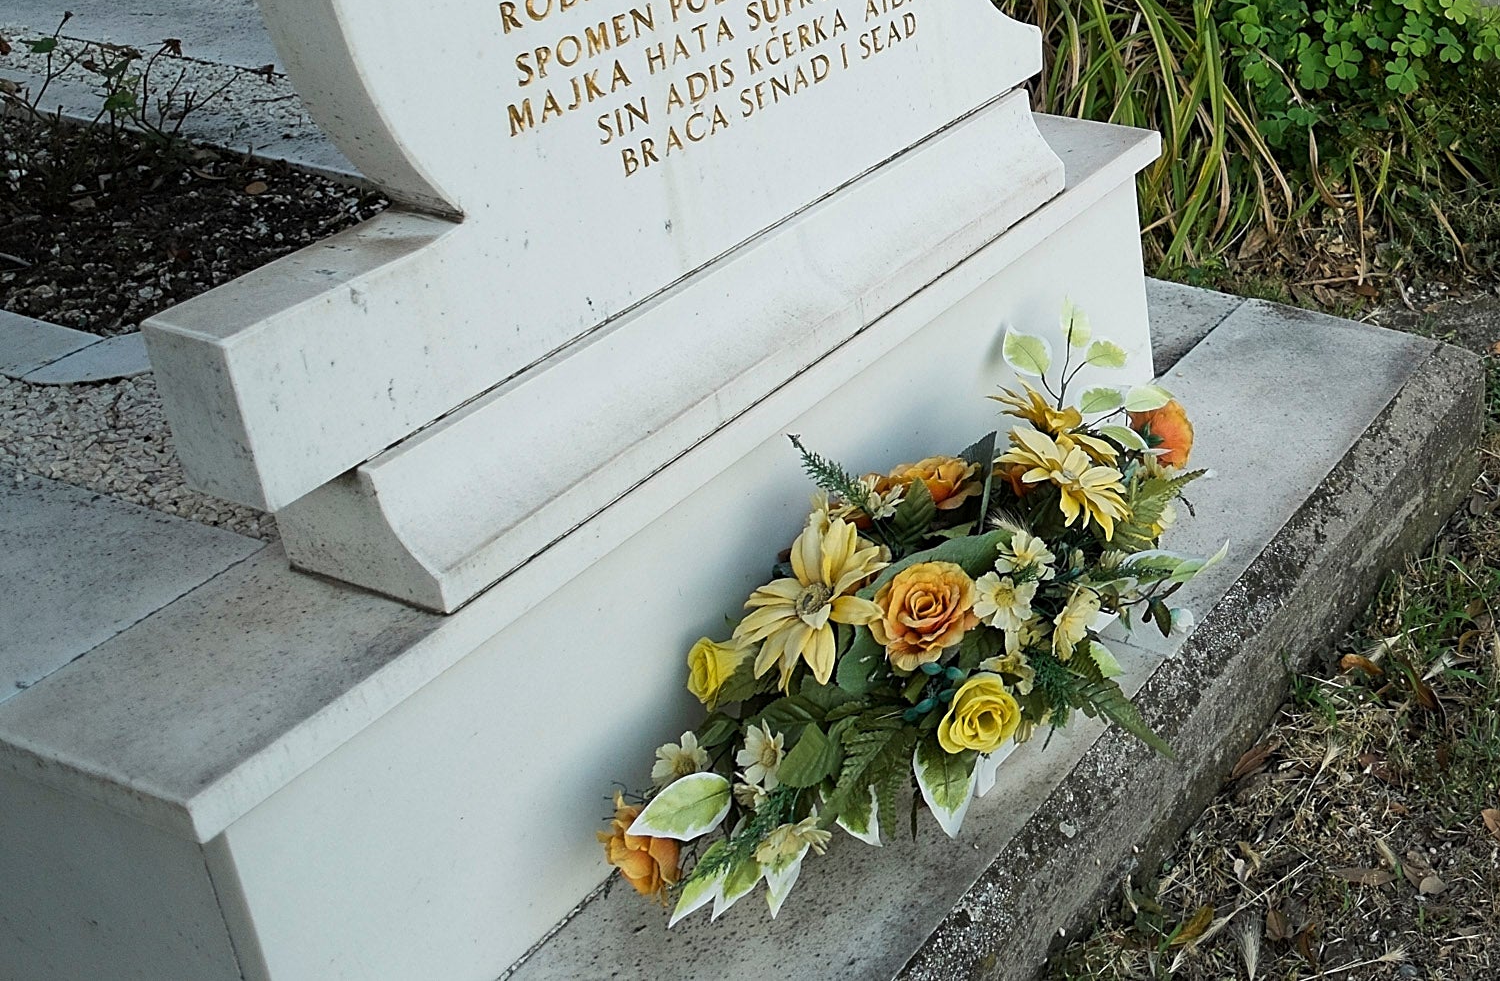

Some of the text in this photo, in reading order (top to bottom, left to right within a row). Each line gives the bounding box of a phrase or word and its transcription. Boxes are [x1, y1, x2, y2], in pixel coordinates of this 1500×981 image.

[507, 59, 632, 138] MAJKA
[645, 16, 735, 76] HATA
[515, 2, 655, 87] SPOMEN
[621, 12, 918, 178] BRAĆA SENAD I SEAD
[597, 96, 650, 145] SIN
[666, 58, 735, 115] ADIS
